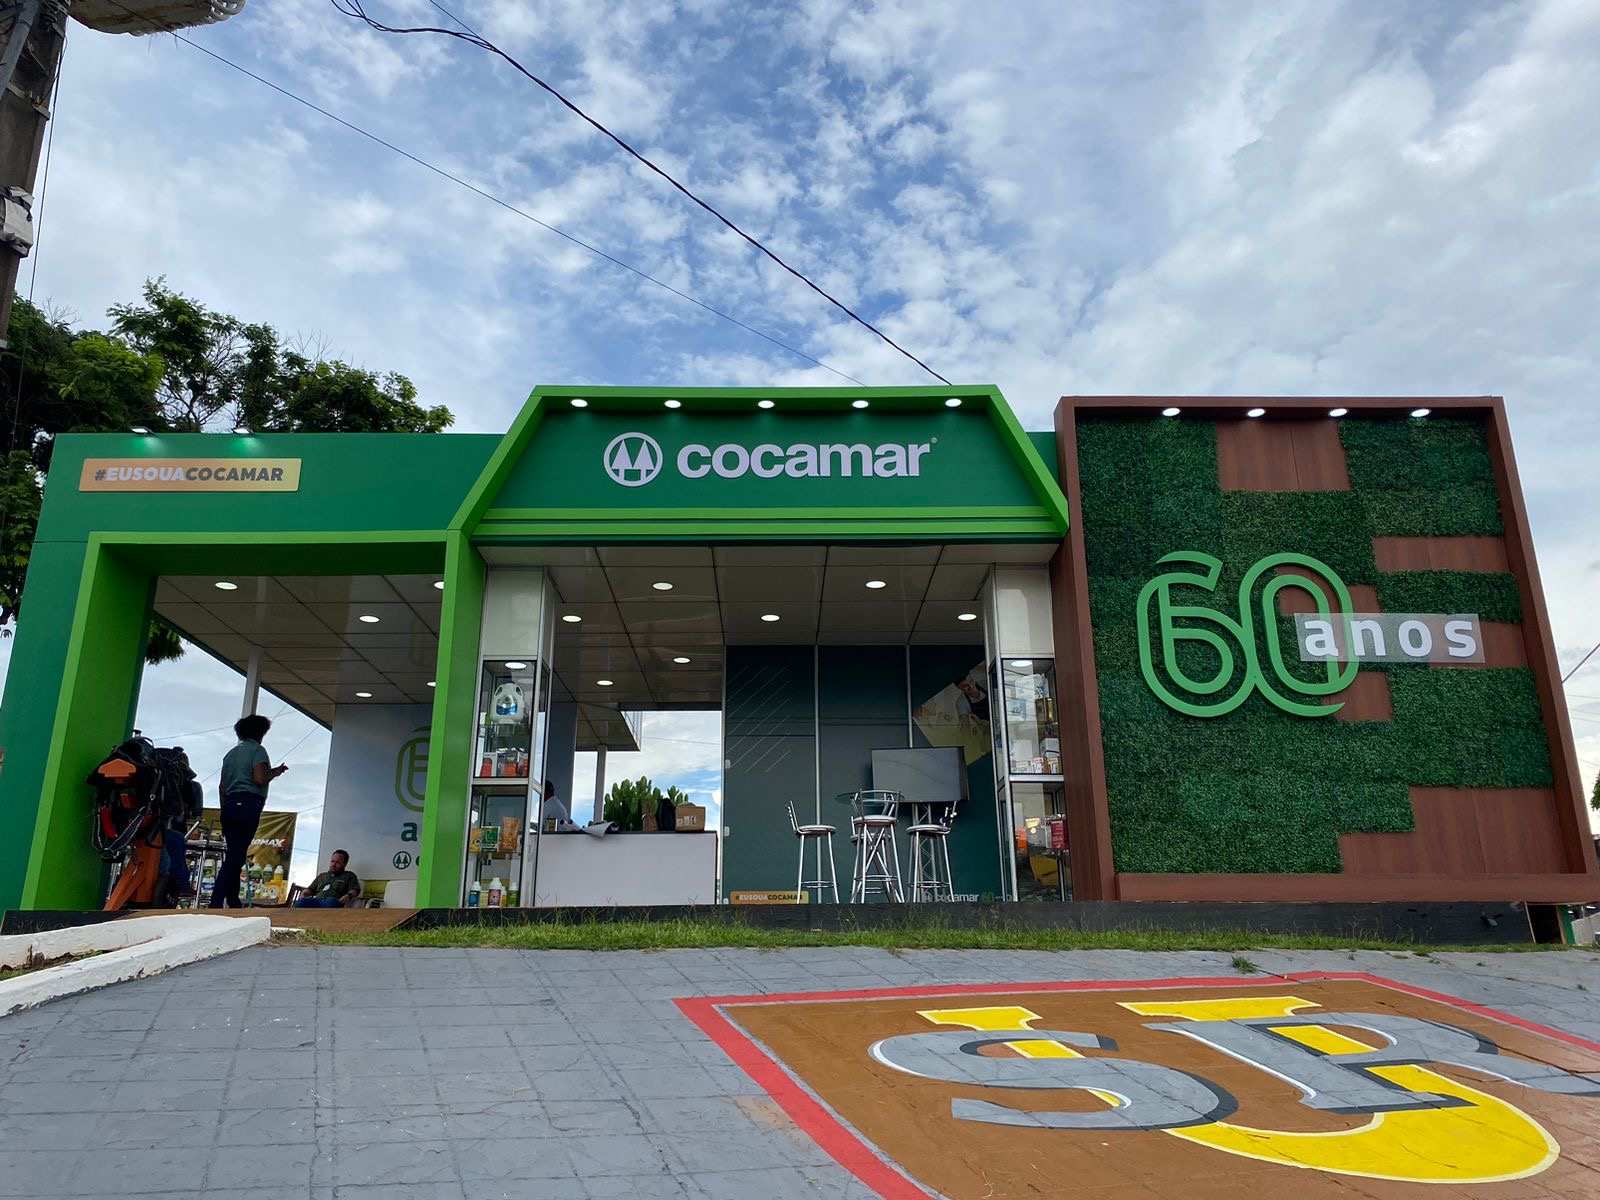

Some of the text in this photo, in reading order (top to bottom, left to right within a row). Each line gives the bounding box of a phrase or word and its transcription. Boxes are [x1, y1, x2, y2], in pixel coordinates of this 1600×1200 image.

[95, 467, 284, 481] #EUSOUACOCAMAR
[677, 443, 931, 478] cocamar
[1136, 551, 1477, 718] 60 anos
